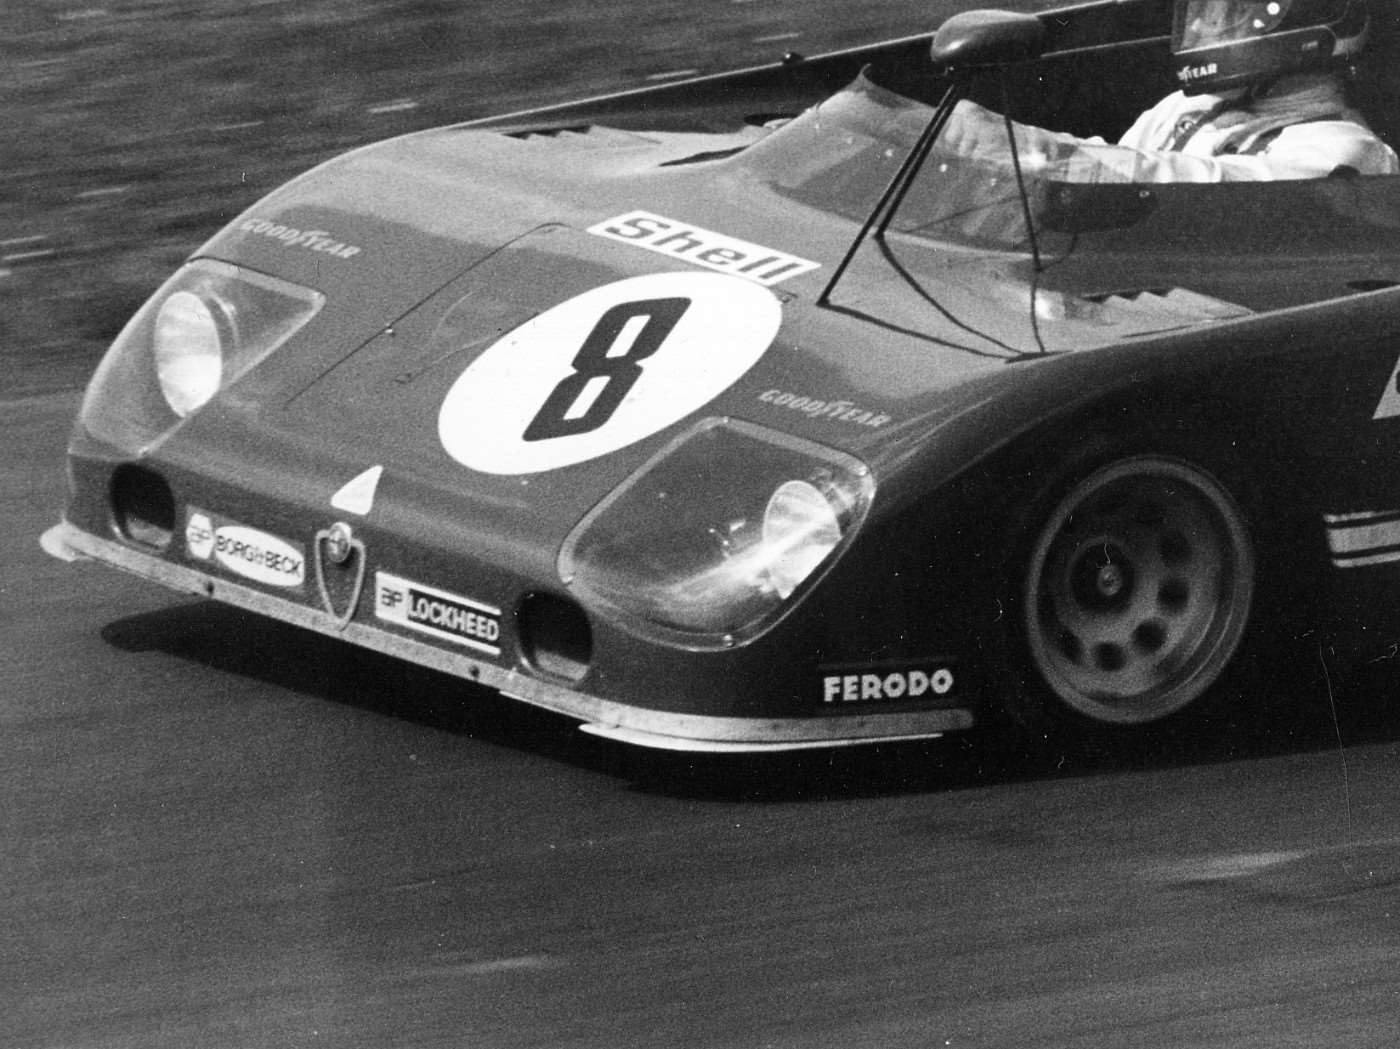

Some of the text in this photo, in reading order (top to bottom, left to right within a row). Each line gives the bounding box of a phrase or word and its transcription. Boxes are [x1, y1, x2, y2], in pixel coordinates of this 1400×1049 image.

[604, 217, 803, 280] Shell
[522, 297, 692, 442] 8
[408, 594, 500, 642] LOCKHEED
[823, 668, 954, 702] FERODO
